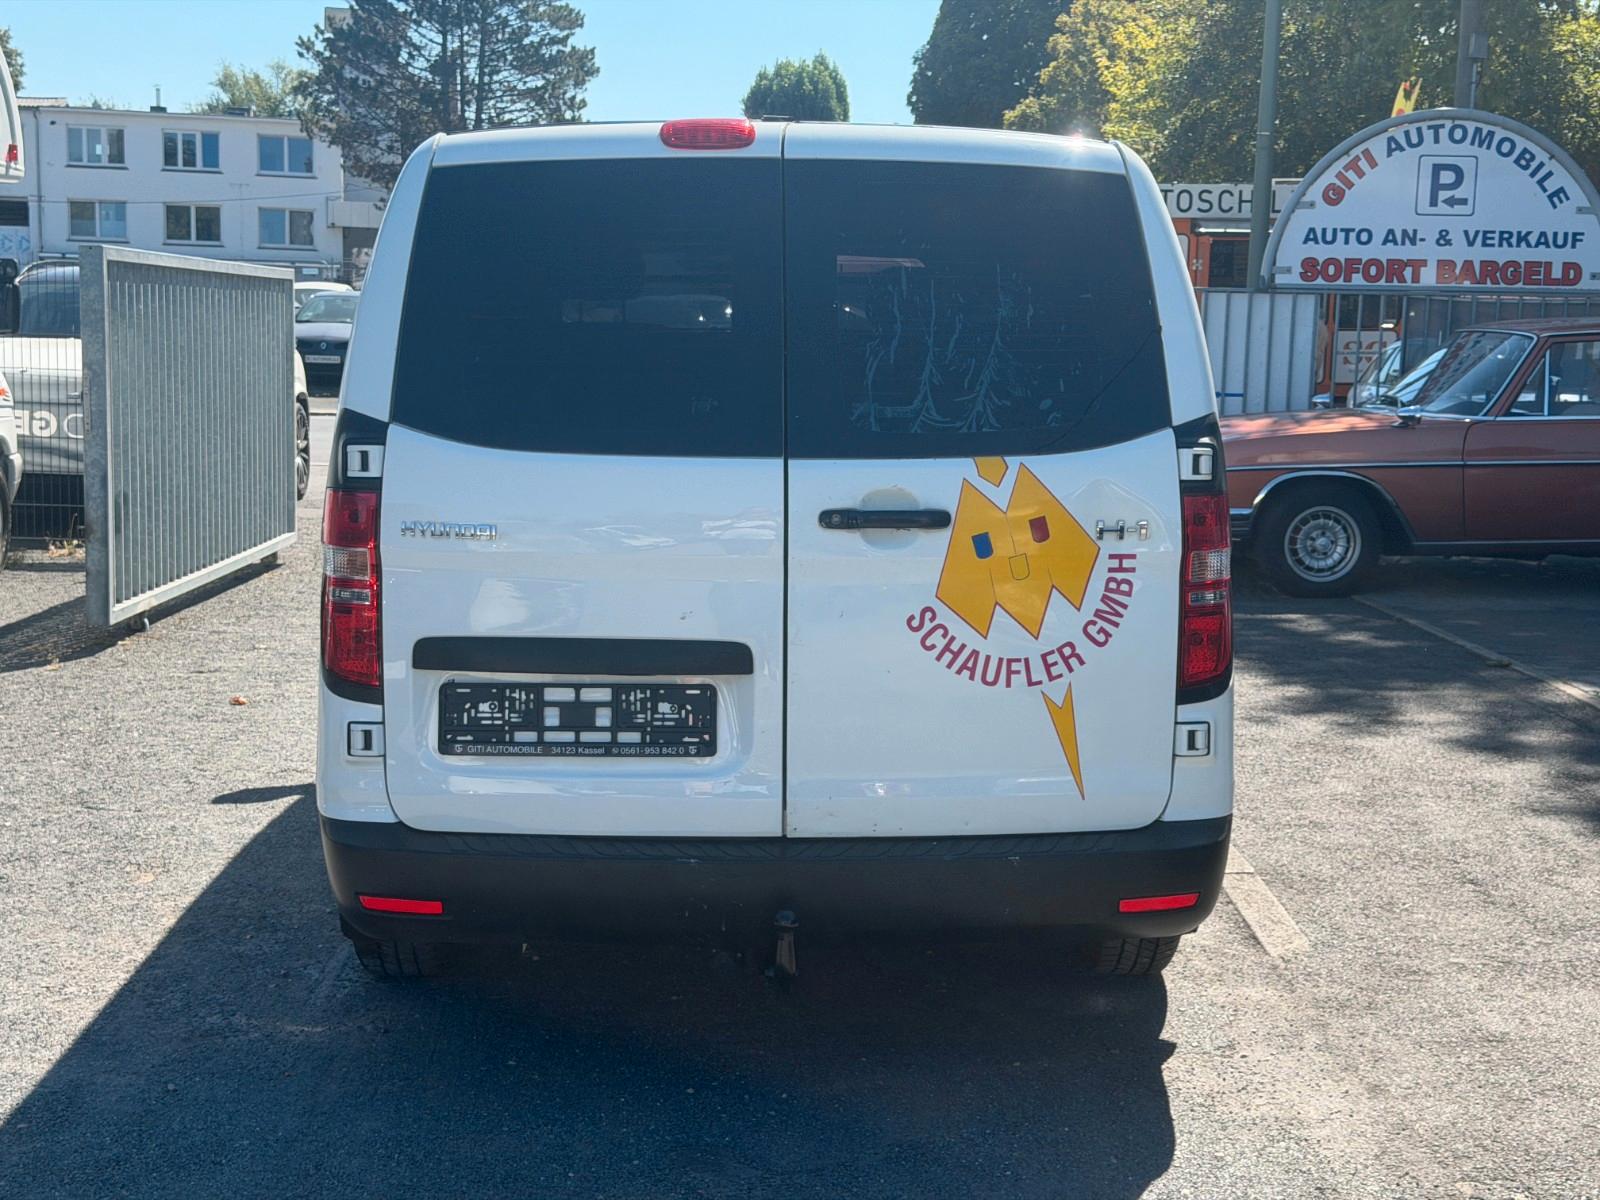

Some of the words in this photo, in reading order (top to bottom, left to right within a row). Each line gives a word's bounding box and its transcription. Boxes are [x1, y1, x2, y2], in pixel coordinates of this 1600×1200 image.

[1322, 148, 1378, 206] GITI
[1386, 123, 1570, 209] AUTOMOBILE
[1429, 164, 1465, 207] P
[1303, 227, 1373, 245] AUTO
[1382, 229, 1426, 246] AN-
[1435, 229, 1453, 247] &
[1463, 230, 1585, 249] VERKAUF
[1300, 257, 1428, 284] SOFORT
[1436, 259, 1583, 287] BARGELD
[401, 521, 497, 540] HYUNDAI
[906, 606, 1086, 688] SCHAUFLER
[1082, 553, 1137, 648] GMBH
[467, 745, 485, 753] GITI
[486, 745, 543, 754] AUTOMOBILE
[551, 746, 576, 754] 34123
[578, 746, 605, 755] Kassel
[662, 746, 677, 755] 842
